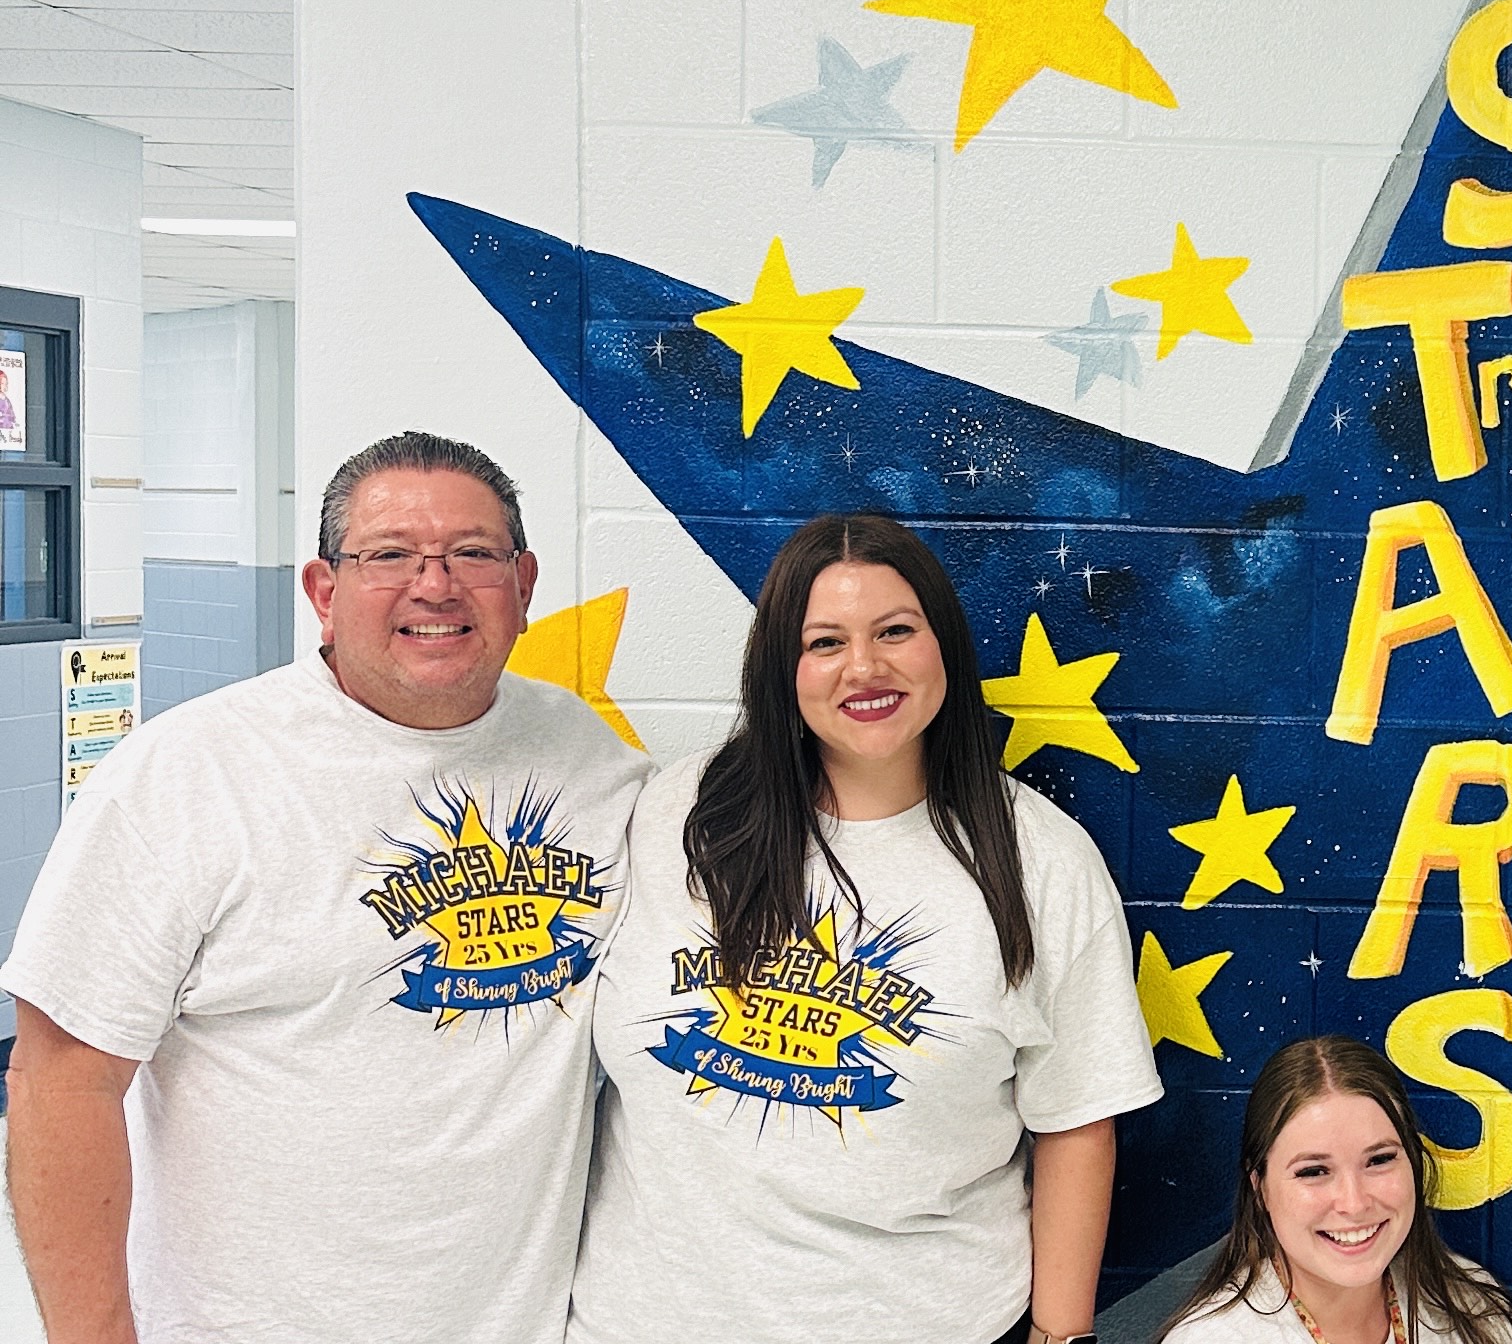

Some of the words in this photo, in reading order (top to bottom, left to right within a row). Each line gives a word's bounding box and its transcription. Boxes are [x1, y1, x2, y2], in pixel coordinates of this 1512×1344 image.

[101, 651, 126, 661] Arrival
[91, 671, 135, 684] Expectations
[359, 842, 603, 940] MICHAEL
[457, 902, 539, 939] STARS
[464, 945, 491, 966] 25
[494, 940, 538, 960] Yrs
[434, 977, 451, 1003] of
[454, 977, 518, 1001] Shining
[521, 956, 574, 995] Bright
[672, 946, 935, 1047] MCHAEL
[742, 993, 842, 1037] STARS
[740, 1026, 770, 1051] 25
[778, 1035, 818, 1062] Yrs
[694, 1048, 713, 1071] of
[712, 1053, 786, 1096] Shining
[789, 1074, 864, 1103] Bright
